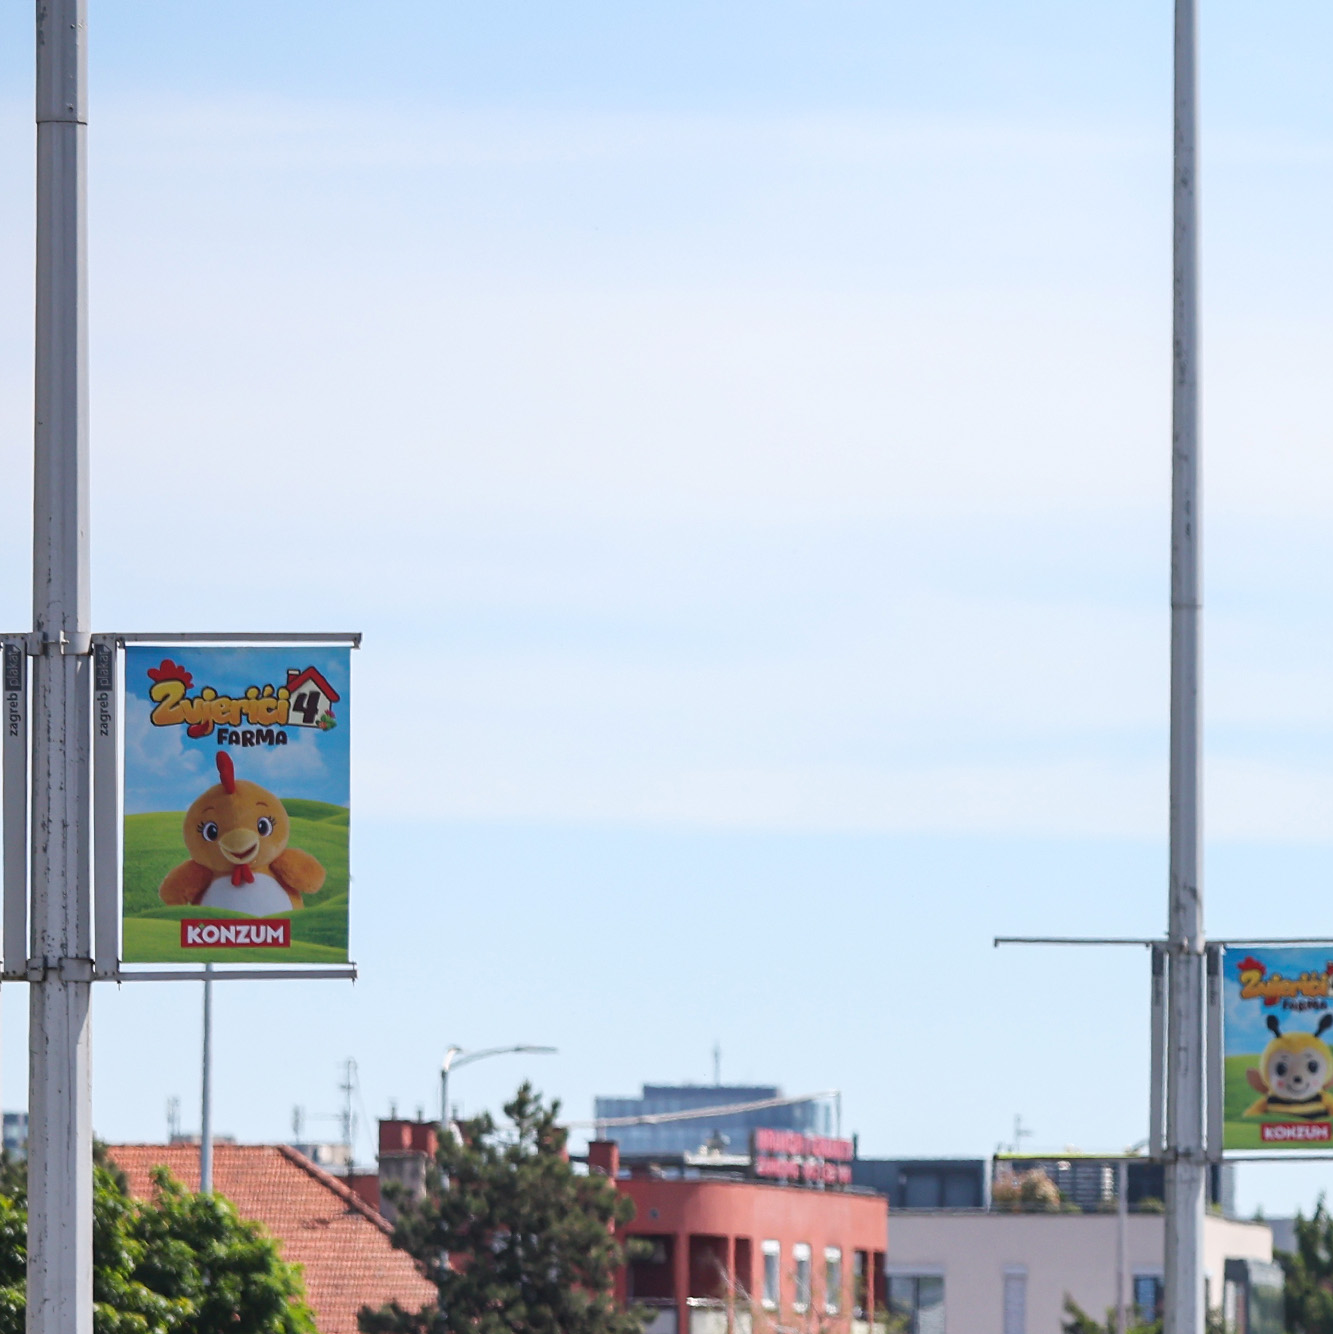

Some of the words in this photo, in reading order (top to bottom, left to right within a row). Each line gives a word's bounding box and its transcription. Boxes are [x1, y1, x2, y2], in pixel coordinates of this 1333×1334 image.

[6, 648, 19, 687] plakat
[97, 648, 109, 687] plakat
[7, 692, 21, 737] zagreb
[97, 692, 111, 737] zagreb
[149, 678, 291, 738] Zvjerići
[292, 690, 321, 724] 4
[216, 728, 288, 748] FARMA
[187, 924, 284, 944] KONZUM
[1264, 1125, 1329, 1140] KONZUM
